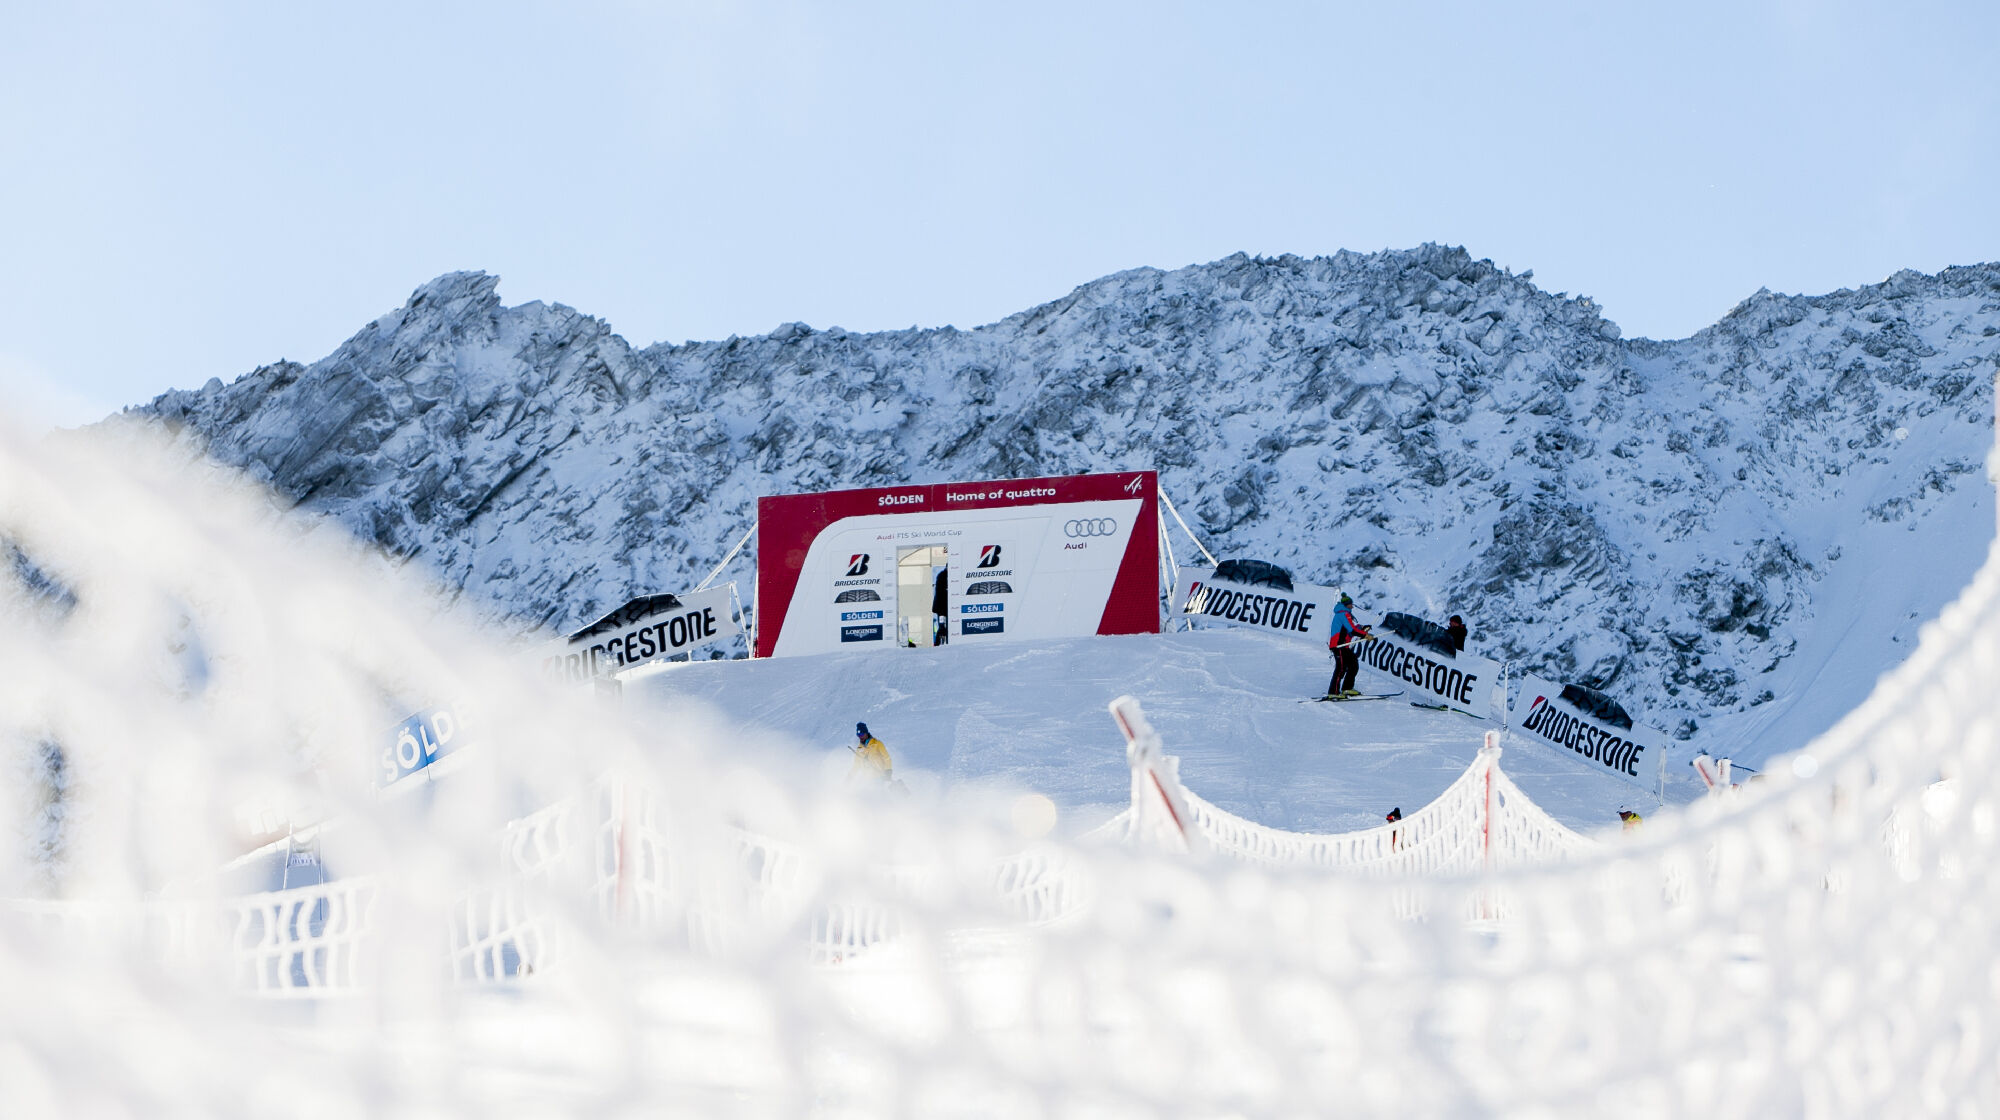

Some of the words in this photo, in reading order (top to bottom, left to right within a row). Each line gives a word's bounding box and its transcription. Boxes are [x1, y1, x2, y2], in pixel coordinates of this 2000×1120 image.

[946, 491, 986, 502] Home
[988, 489, 1004, 500] of
[1006, 486, 1056, 501] quattro
[878, 493, 924, 507] SÖLDEN
[923, 530, 946, 538] World
[947, 530, 963, 538] Cup
[1064, 541, 1088, 550] Audi
[965, 569, 1013, 579] BRIDGESTONE
[834, 578, 881, 587] BRIDGESTONE
[967, 604, 999, 613] SÖLDEN
[1184, 581, 1317, 633] BRIDGESTONE
[846, 612, 878, 621] SÖLDEN
[1523, 694, 1645, 777] BRIDGESTONE
